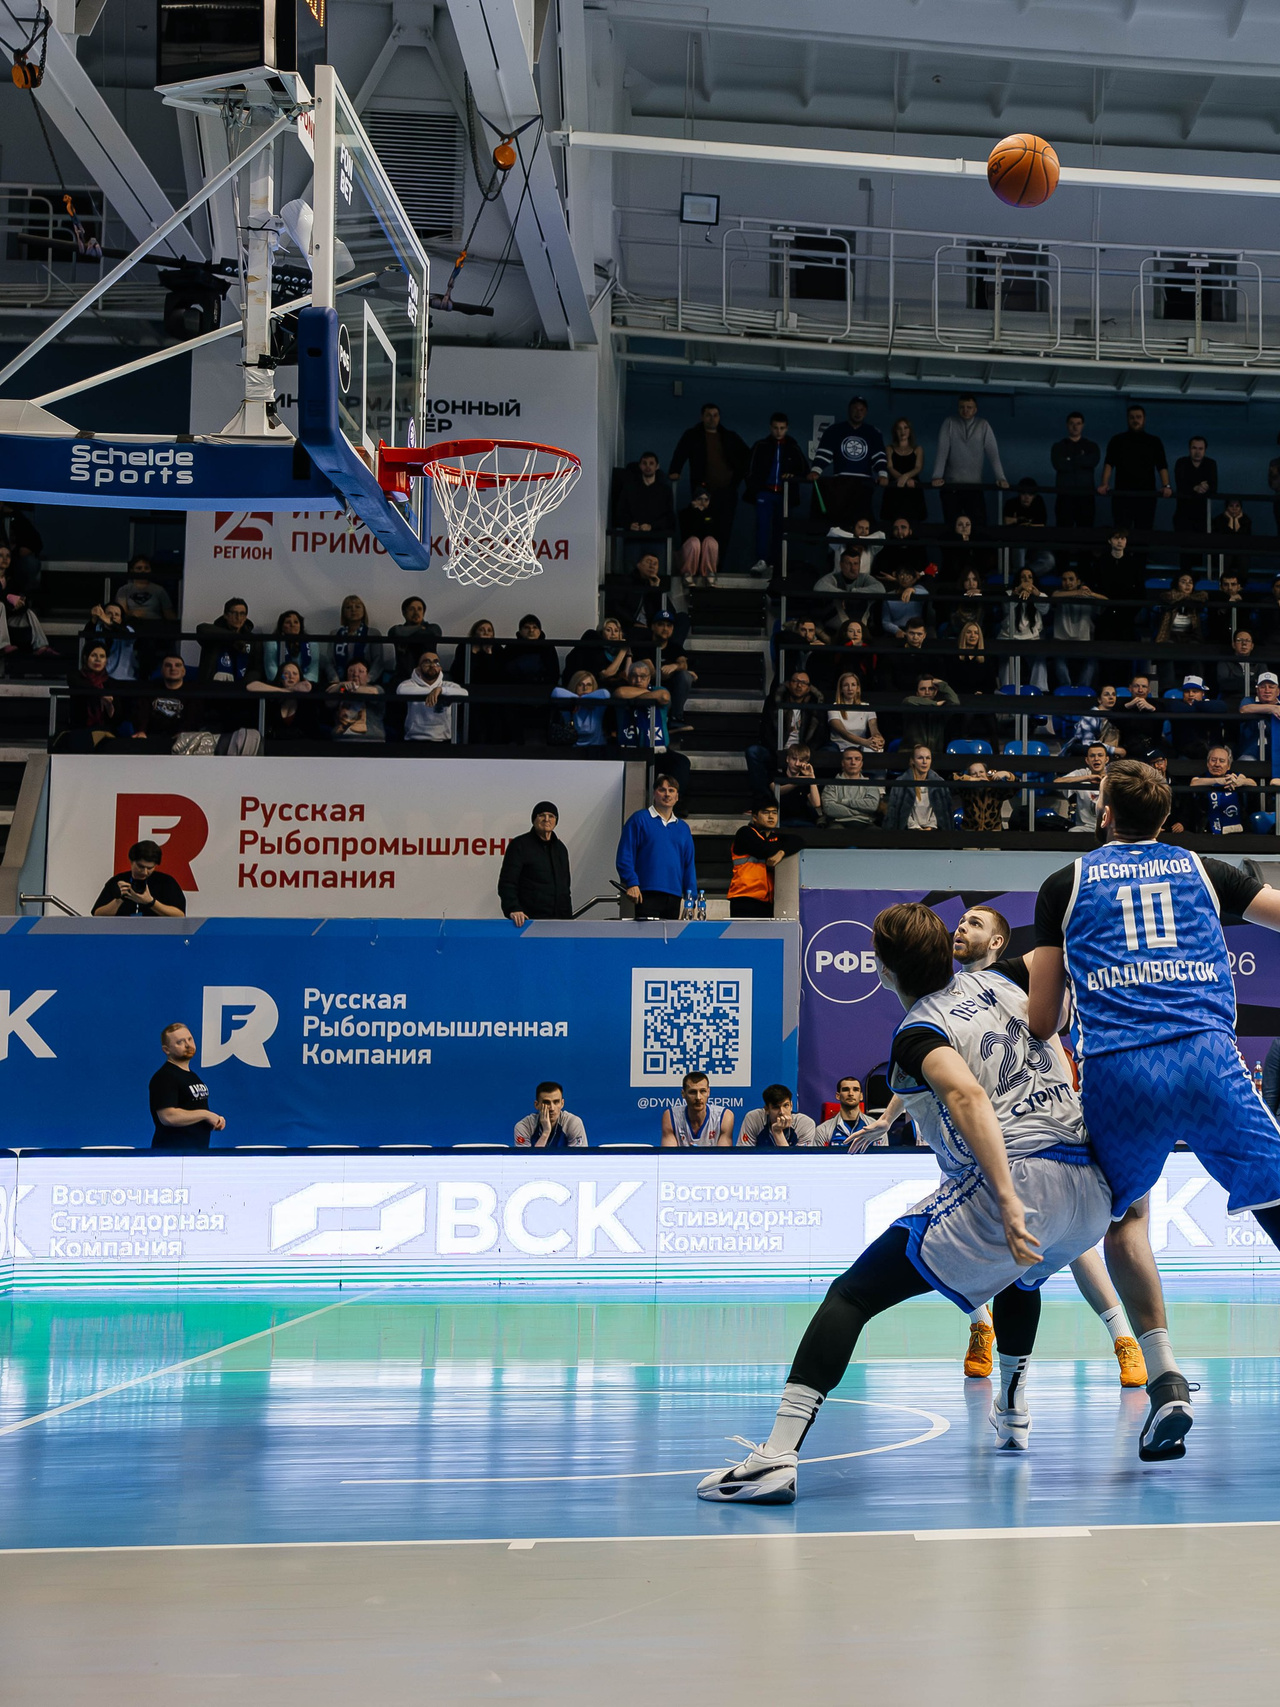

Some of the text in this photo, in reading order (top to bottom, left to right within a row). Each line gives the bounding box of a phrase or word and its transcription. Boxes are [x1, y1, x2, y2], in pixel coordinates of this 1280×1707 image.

[71, 445, 194, 466] Schelde
[70, 463, 194, 487] Sports
[213, 545, 272, 560] РЕГИОН
[240, 796, 365, 828] Русская
[239, 829, 512, 862] Рыбопромышлен
[238, 863, 395, 888] Компания
[1088, 858, 1192, 883] ДЕСЯТНИКОВ
[1116, 882, 1178, 951] 10
[816, 950, 877, 973] РФБ
[1087, 960, 1219, 992] ВЛАДИВОСТОК
[304, 988, 407, 1015] Русская
[303, 1015, 569, 1042] Рыбопромышленная
[302, 1044, 432, 1065] Компания
[637, 1097, 744, 1110] @DYNA5PRIM
[52, 1185, 190, 1205] Восточная
[660, 1181, 788, 1202] Восточная
[51, 1211, 226, 1235] Стивидорная
[436, 1180, 645, 1259] ВСК
[660, 1207, 822, 1230] Стивидорная
[49, 1238, 183, 1259] Компания
[659, 1232, 784, 1252] Компания
